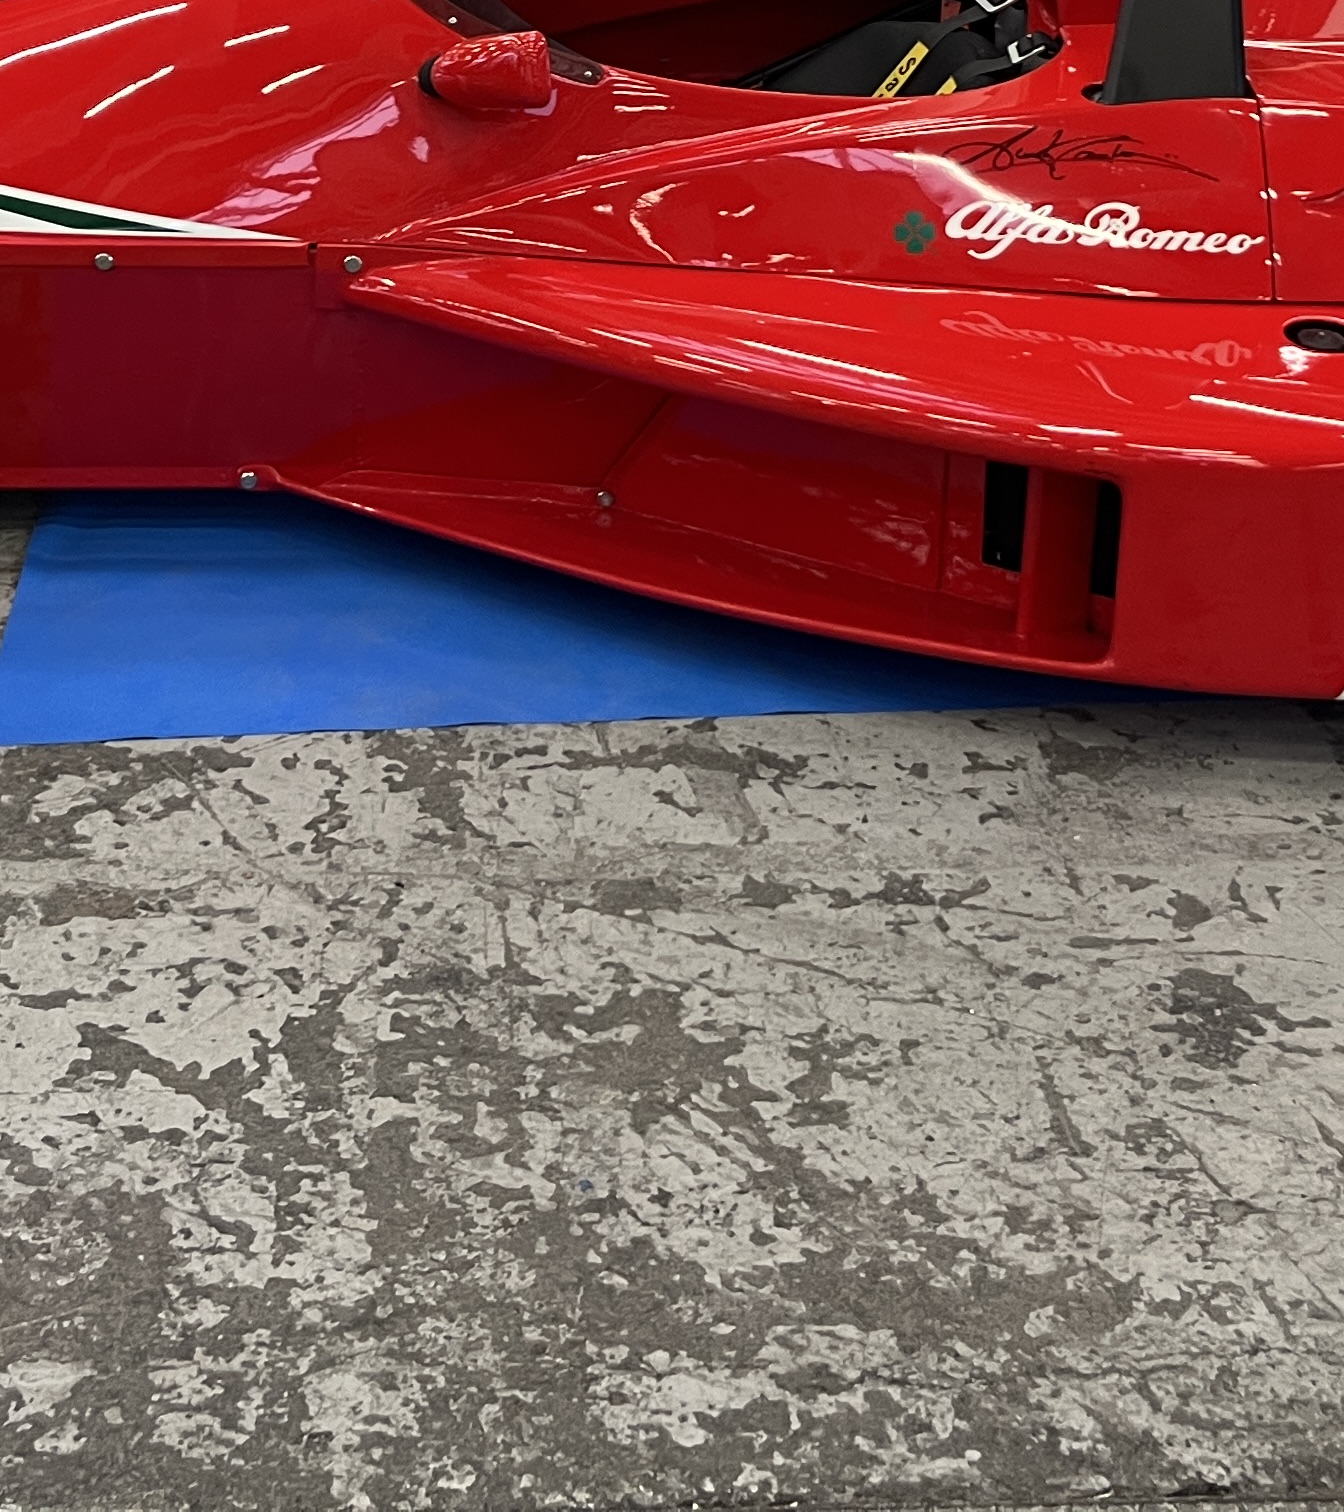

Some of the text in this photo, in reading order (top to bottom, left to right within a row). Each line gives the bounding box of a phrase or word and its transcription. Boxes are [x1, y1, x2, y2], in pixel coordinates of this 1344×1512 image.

[877, 57, 917, 98] Sa
[945, 199, 1265, 260] Alfa Romeo
